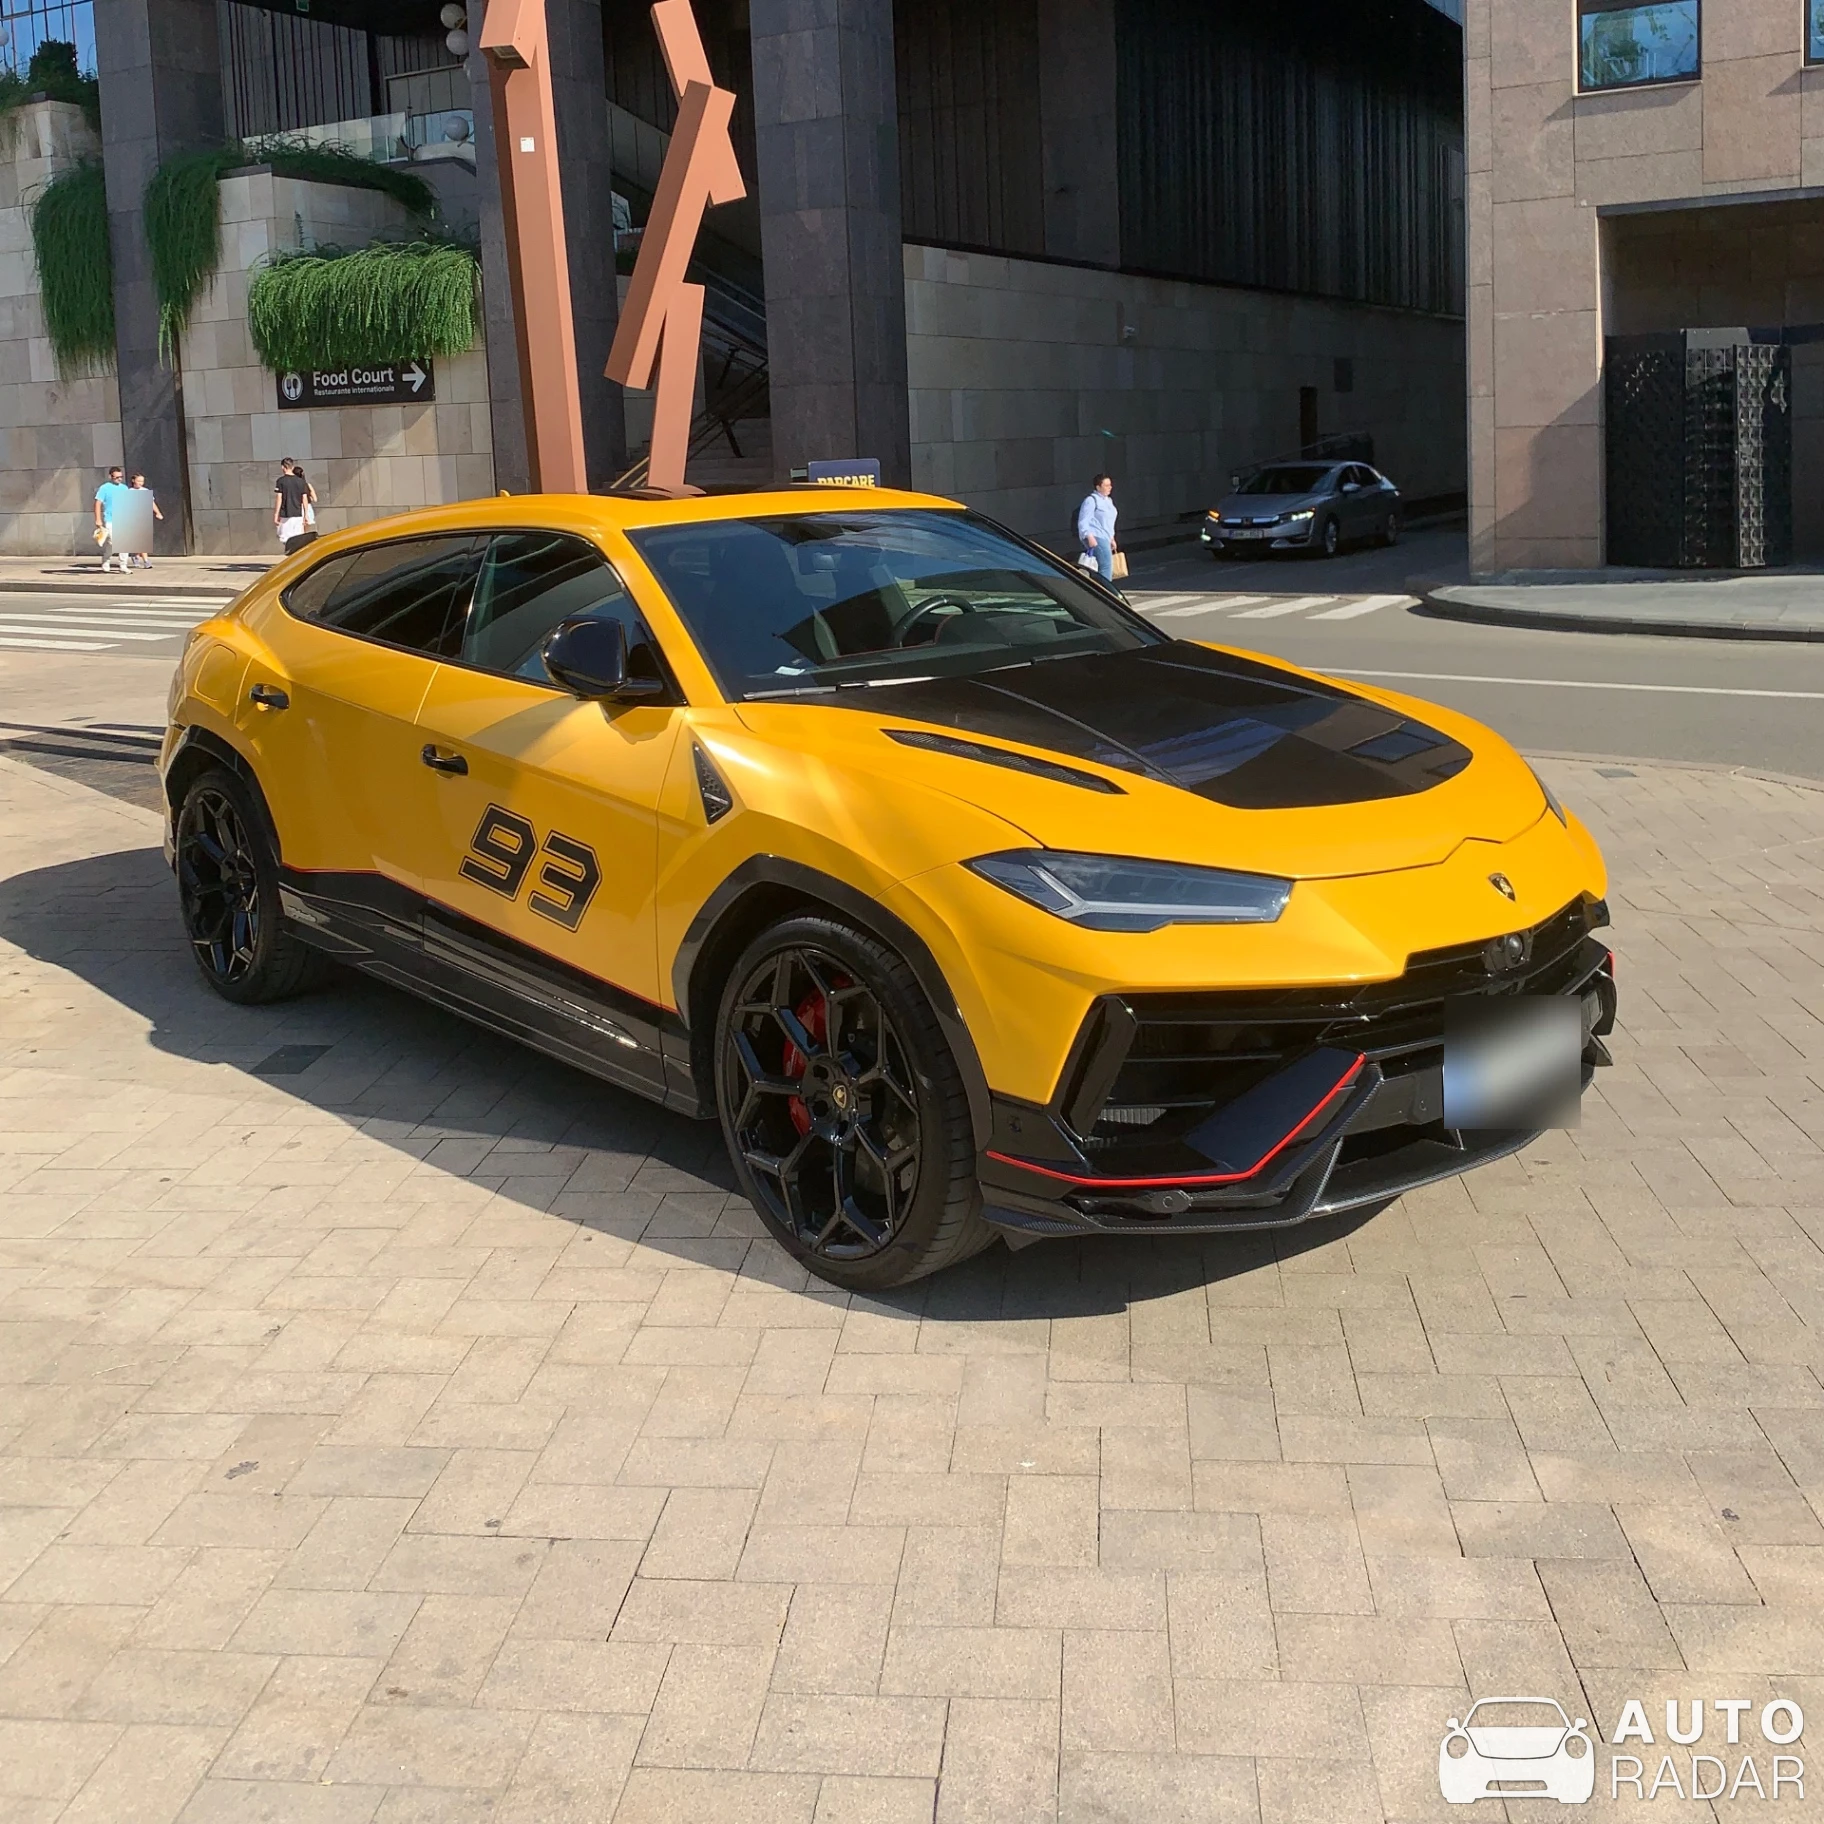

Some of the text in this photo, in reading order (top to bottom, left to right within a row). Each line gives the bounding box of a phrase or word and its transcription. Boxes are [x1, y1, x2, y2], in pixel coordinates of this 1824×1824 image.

[313, 367, 394, 387] Food Court
[314, 387, 351, 396] Restaurante
[458, 803, 602, 933] 93
